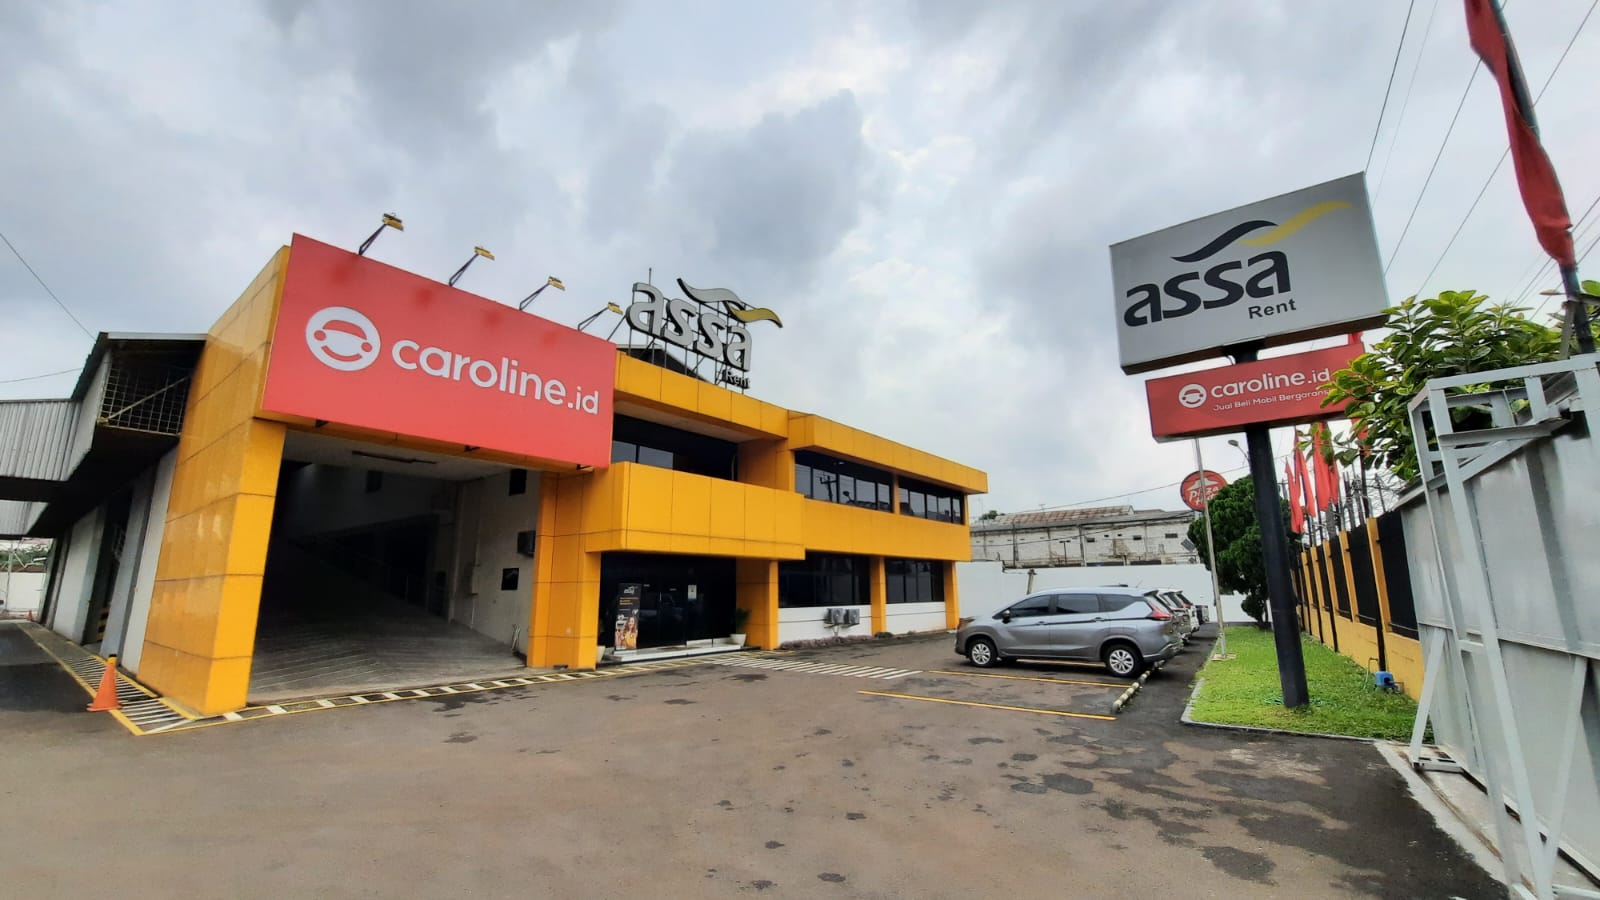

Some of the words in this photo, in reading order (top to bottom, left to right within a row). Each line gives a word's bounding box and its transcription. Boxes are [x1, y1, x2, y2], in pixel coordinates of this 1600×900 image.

[1123, 250, 1292, 327] assa
[1247, 298, 1297, 319] Rent
[626, 282, 752, 372] assa
[391, 339, 599, 415] caroline.id
[1211, 367, 1331, 398] caroline.id
[1213, 402, 1233, 411] Jual
[1234, 399, 1251, 408] Beli
[1252, 395, 1277, 405] Mobil
